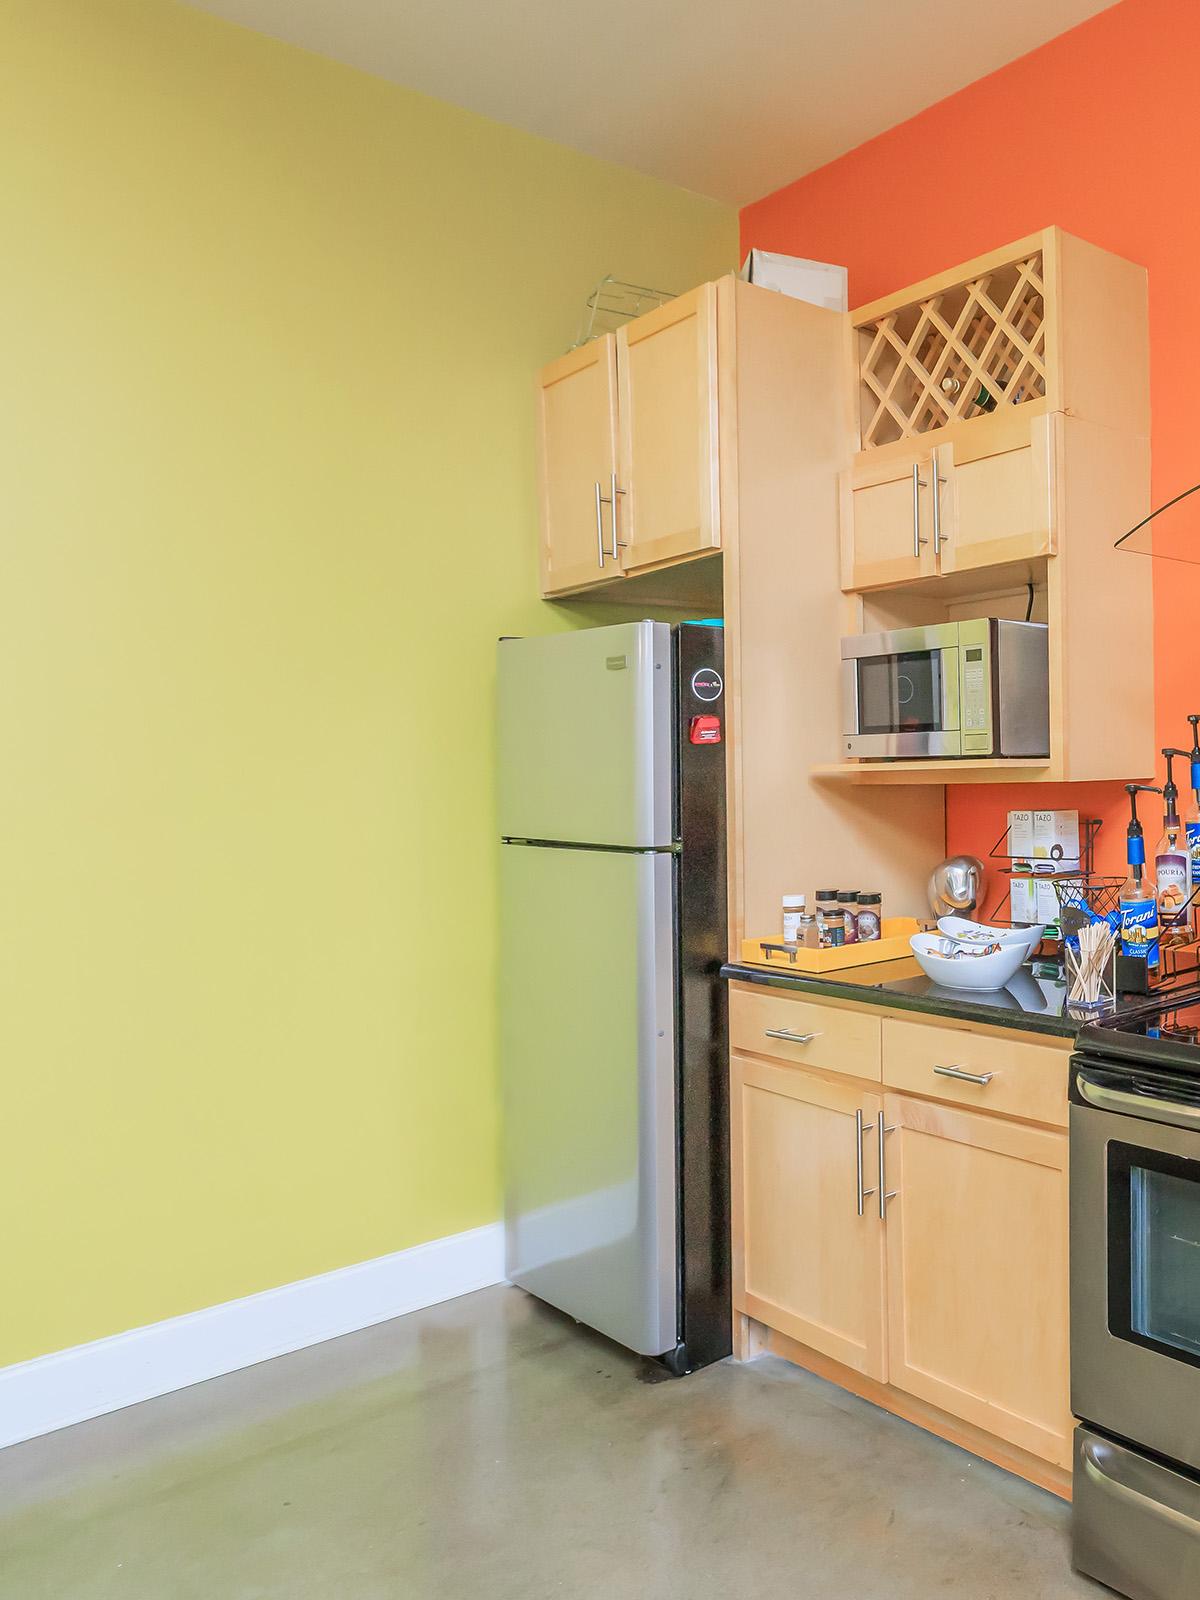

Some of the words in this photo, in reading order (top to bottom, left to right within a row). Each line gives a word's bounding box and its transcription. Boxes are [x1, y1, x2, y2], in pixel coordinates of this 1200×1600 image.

[1013, 813, 1029, 822] TAZO
[1036, 814, 1052, 822] TAZO
[1120, 905, 1155, 930] Torani
